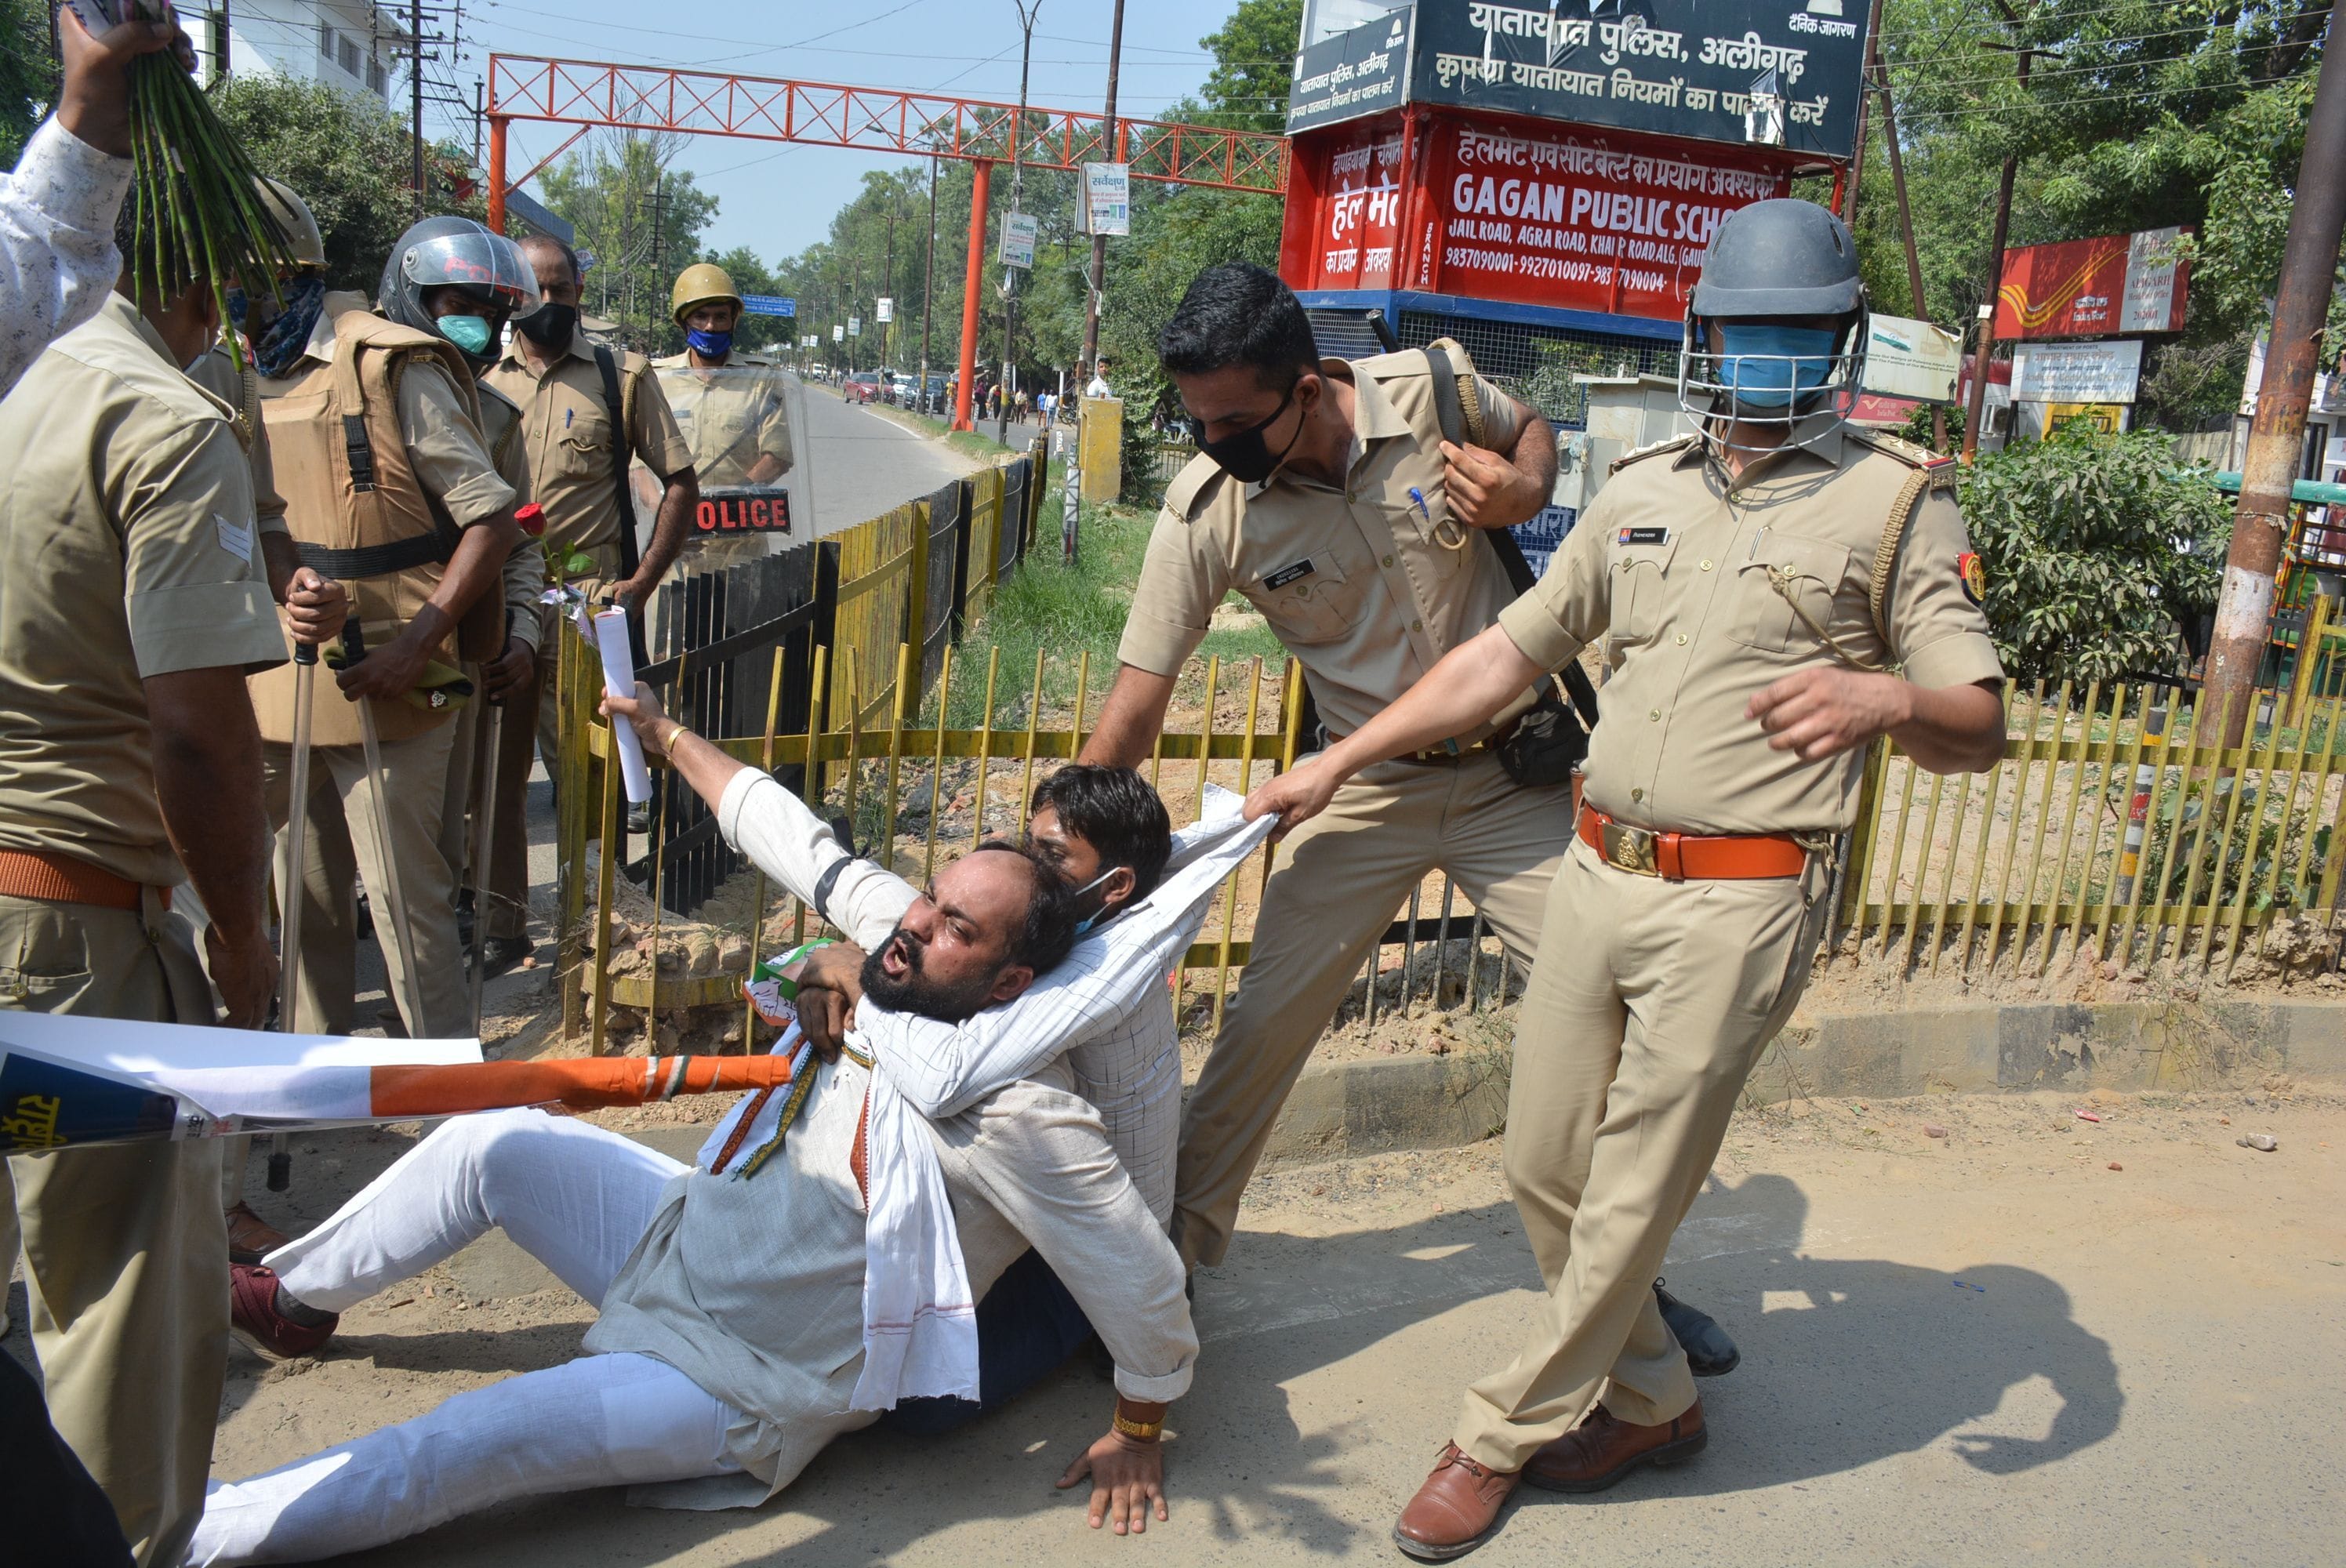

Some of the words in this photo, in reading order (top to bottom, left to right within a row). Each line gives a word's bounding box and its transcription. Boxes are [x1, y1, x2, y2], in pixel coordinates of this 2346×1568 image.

[1819, 20, 1857, 39] जागरण
[1300, 73, 1330, 94] यातायात
[1330, 63, 1354, 93] पुलिस,
[1357, 52, 1389, 77] अलीगढ़
[1308, 97, 1331, 114] यातायात
[1352, 89, 1360, 103] का
[1362, 83, 1380, 100] पालन
[1512, 62, 1606, 98] यातायात
[1611, 68, 1684, 108] नियमों
[1686, 87, 1717, 111] का
[1789, 95, 1829, 125] करें
[1458, 123, 1529, 166] हेलमेट
[1632, 154, 1655, 186] का
[1654, 153, 1709, 194] प्रयोग
[1454, 173, 1565, 223] GAGAN
[1570, 187, 1670, 237] PUBLIC
[1421, 222, 1434, 285] BRANCH
[1449, 218, 1476, 240] JAIL
[1479, 220, 1513, 245] ROAD,
[1517, 225, 1552, 249] AGRA
[1555, 230, 1587, 256] ROAD,
[1326, 251, 1338, 274] का
[696, 499, 786, 530] OLICE
